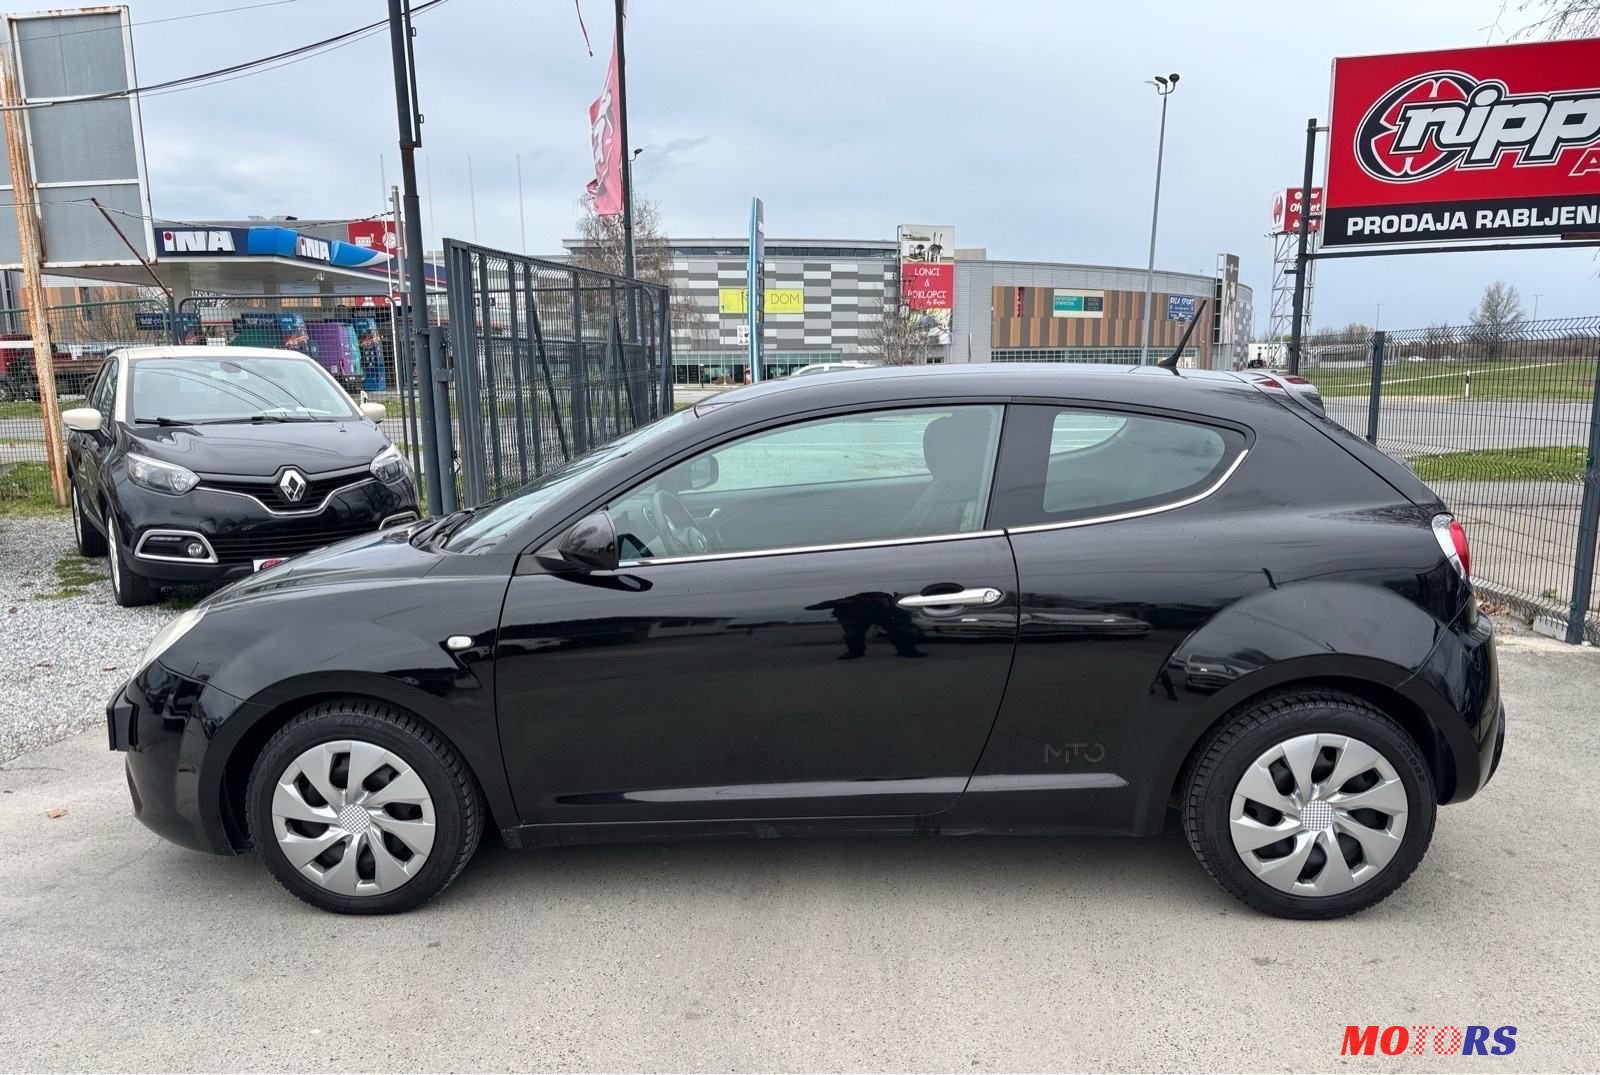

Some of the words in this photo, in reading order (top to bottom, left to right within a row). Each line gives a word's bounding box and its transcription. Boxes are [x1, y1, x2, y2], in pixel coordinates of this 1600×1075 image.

[1346, 211, 1469, 236] PRODAJA
[1475, 205, 1600, 229] RABLJEN
[914, 267, 941, 277] LONCI
[770, 293, 800, 305] DOM
